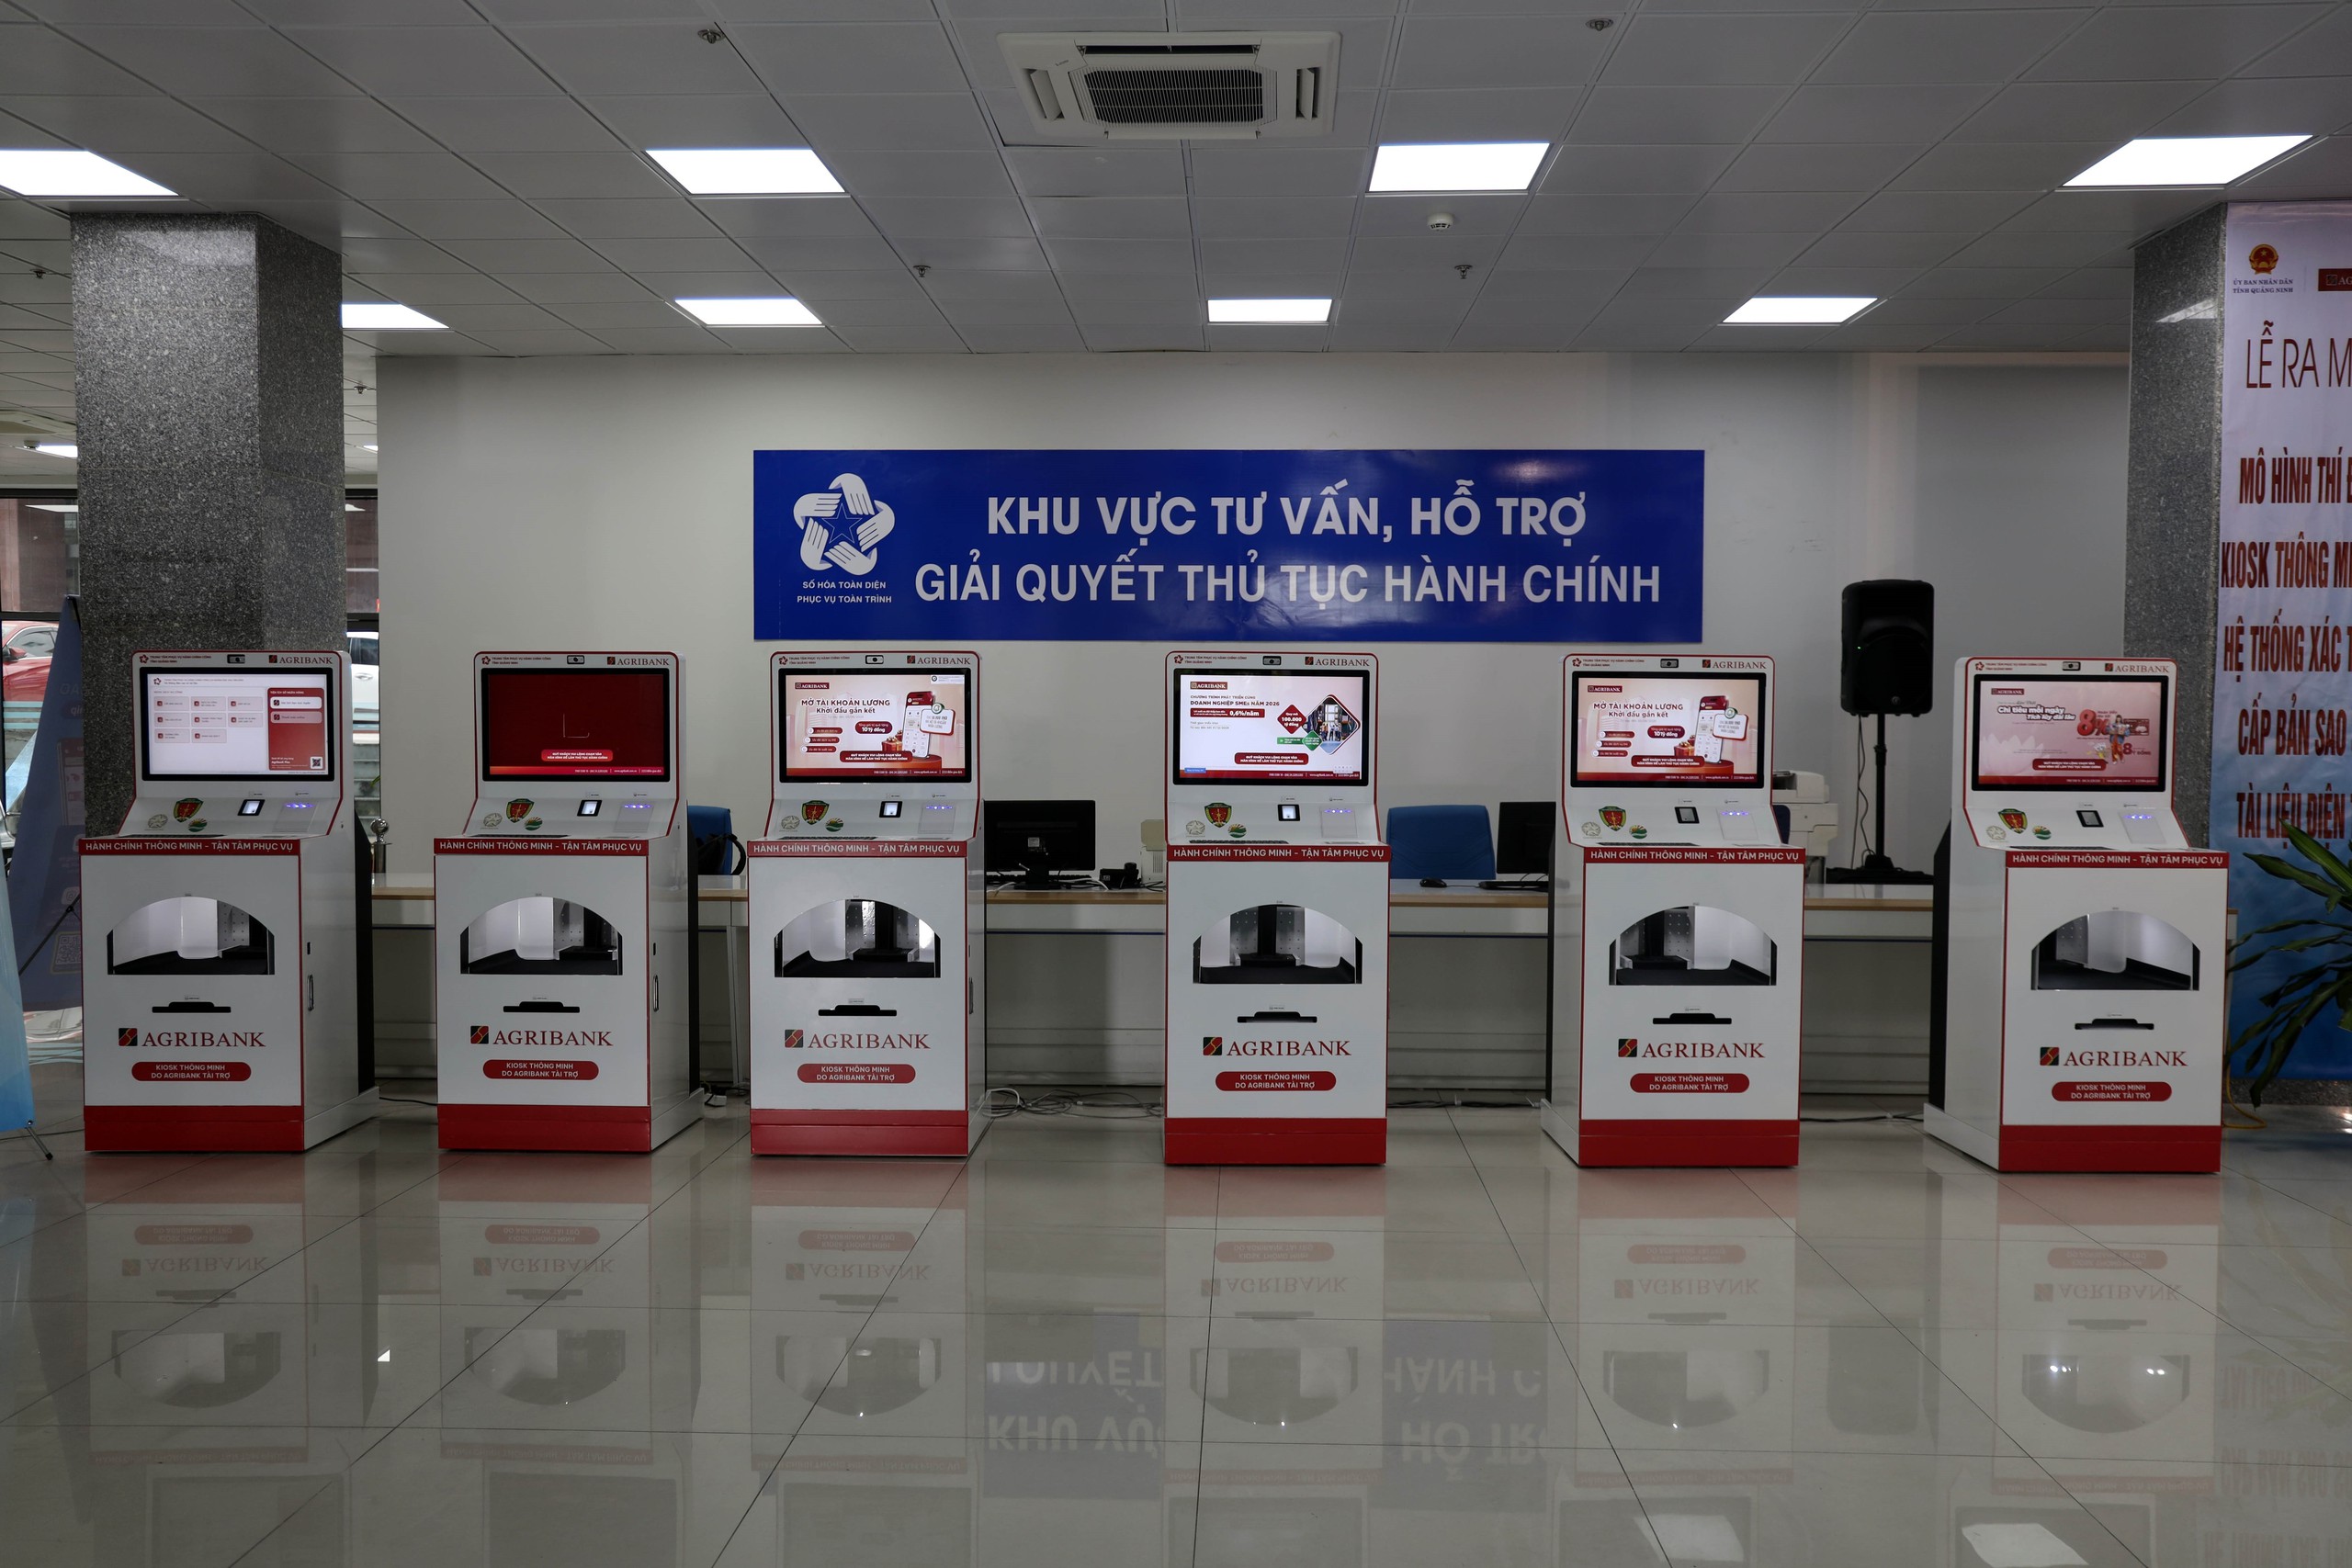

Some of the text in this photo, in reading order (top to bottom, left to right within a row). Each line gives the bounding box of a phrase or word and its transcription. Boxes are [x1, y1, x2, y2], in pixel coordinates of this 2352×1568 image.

[2246, 321, 2352, 388] LỄ RA M
[2239, 447, 2266, 504] MÔ
[2272, 447, 2312, 503] HÌNH
[2317, 446, 2342, 503] THÍ
[988, 479, 1587, 547] KHU VỰC TƯ VẤN, HỖ TRỢ
[2221, 531, 2352, 588] KIOSK THÔNG MI
[803, 579, 886, 590] SỐ HÓA TOÀN DIỆN
[915, 550, 1661, 613] GIẢI QUYẾT THỦ TỤC HÀNH CHÍNH
[797, 594, 891, 604] PHỤC VỤ TOÀN TRÌNH
[2223, 615, 2245, 682] HỆ
[2250, 608, 2303, 672] THỐNG
[2309, 615, 2341, 672] XÁC
[2238, 692, 2346, 756] CẤP BẢN SAO
[2236, 783, 2261, 839] TÀI
[86, 841, 293, 853] HÀNH CHÍNH THÔNG MINH TẬN TÂM PHỤC VỤ
[440, 840, 641, 852] HÀNH CHÍNH THÔNG MINH TẬN TÂM PHỤC VỤ
[753, 844, 959, 855] HÀNH CHÍNH THÔNG MINH TẬN TÂM PHỤC VỤ
[1174, 848, 1384, 860] HÀNH CHÍNH THÔNG MINH TẬN TÂM PHỤC VỤ
[1591, 850, 1798, 863] HÀNH CHÍNH THÔNG MINH TẬN TÂM PHỤC VỤ
[2013, 854, 2222, 866] HÀNH CHÍNH THÔNG MINH TẬN TÂM PHỤC VỤ
[141, 1032, 266, 1046] AGRIBANK
[493, 1031, 613, 1045] AGRIBANK
[808, 1033, 930, 1048] AGRIBANK
[1227, 1041, 1351, 1055] AGRIBANK
[1642, 1043, 1765, 1057] AGRIBANK
[2064, 1051, 2188, 1066] AGRIBANK
